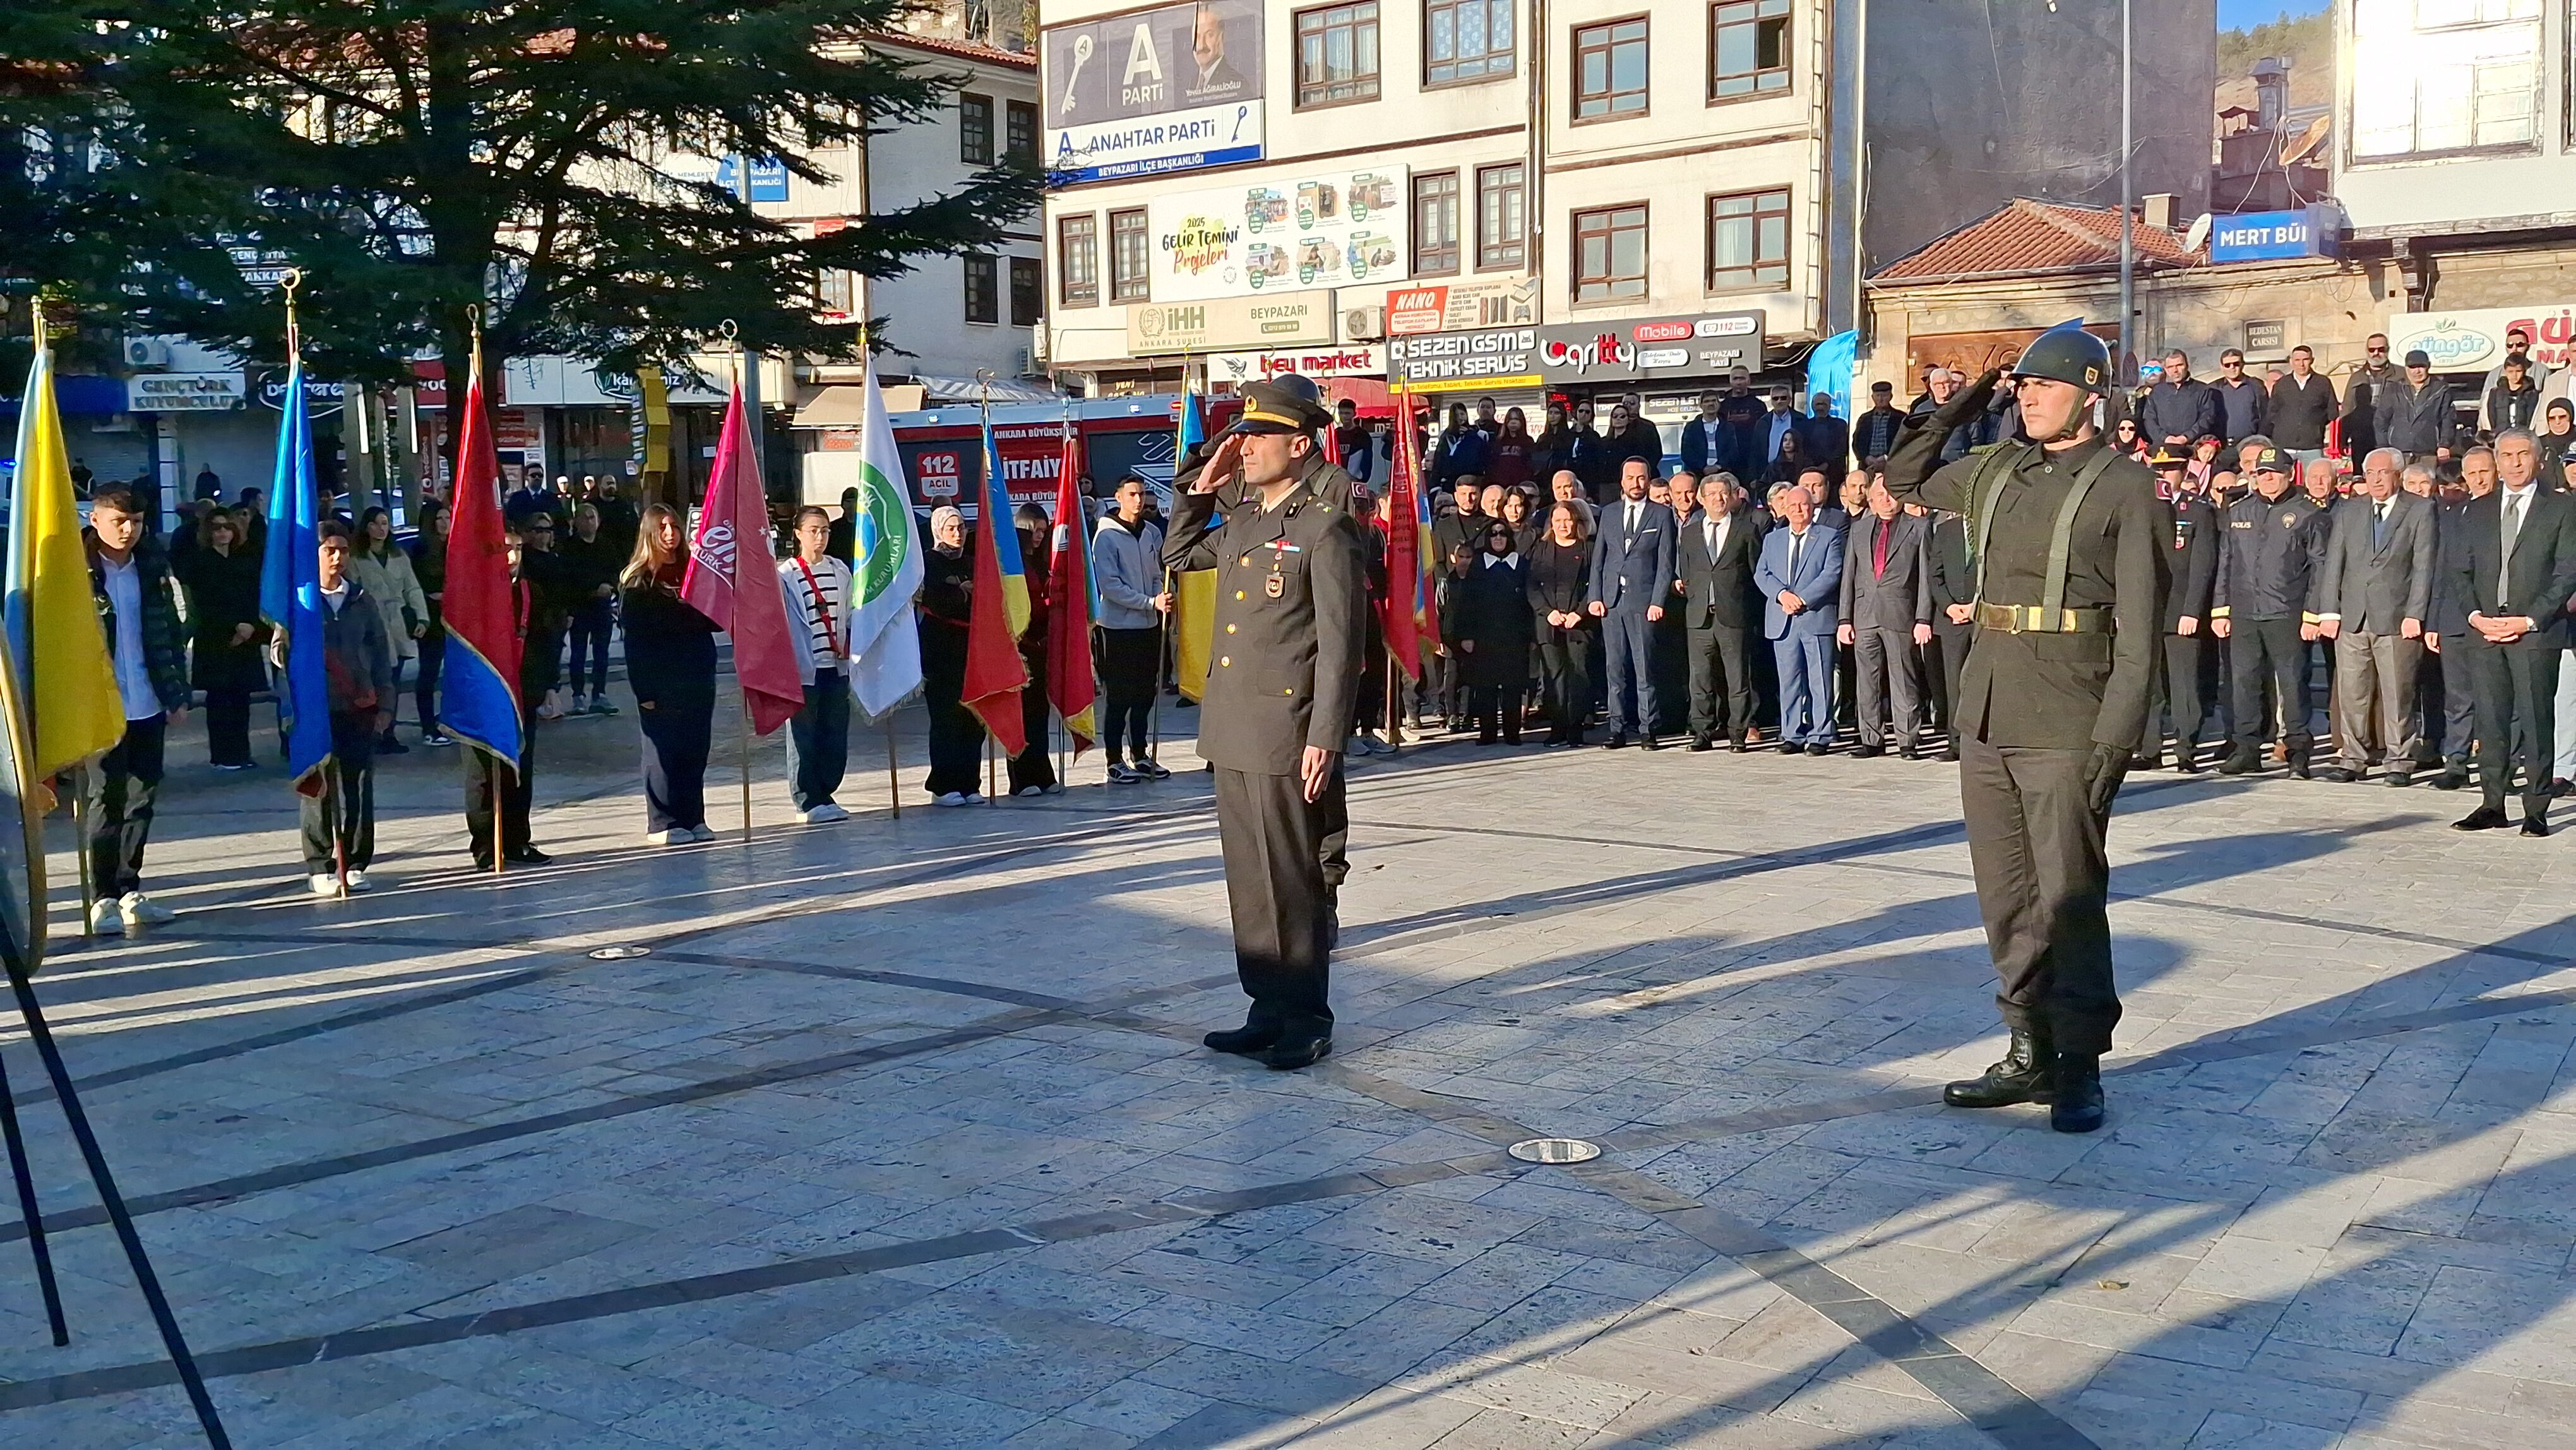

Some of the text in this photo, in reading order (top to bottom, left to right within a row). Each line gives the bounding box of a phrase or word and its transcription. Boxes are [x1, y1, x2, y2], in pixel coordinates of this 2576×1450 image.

[1123, 23, 1162, 85] A
[1089, 129, 1164, 153] ANAHTAR
[1099, 153, 1204, 177] BEYPAZARI İLÇE BAŞKANLIĞI
[1187, 217, 1205, 228] 2025
[1162, 225, 1239, 251] GELİR TEMİNİ
[2221, 227, 2270, 247] MERT
[1174, 241, 1229, 276] Projeleri
[1396, 292, 1435, 310] NANO
[1251, 304, 1308, 319] BEYPAZARI
[1720, 322, 1733, 331] 112
[2506, 309, 2576, 345] GÜ
[1140, 339, 1172, 347] ANKARA
[1407, 332, 1517, 357] SEZEN GSM
[1303, 349, 1371, 371] market
[1700, 349, 1739, 359] BEYPAZARI
[134, 395, 239, 409] KUYUMCULU
[994, 426, 1078, 439] ANKARA BÜYÜKŞEİR
[922, 455, 955, 473] 112
[1003, 455, 1061, 480] İTFAİY
[1009, 492, 1032, 501] KARA
[873, 535, 902, 589] KURUMLARI
